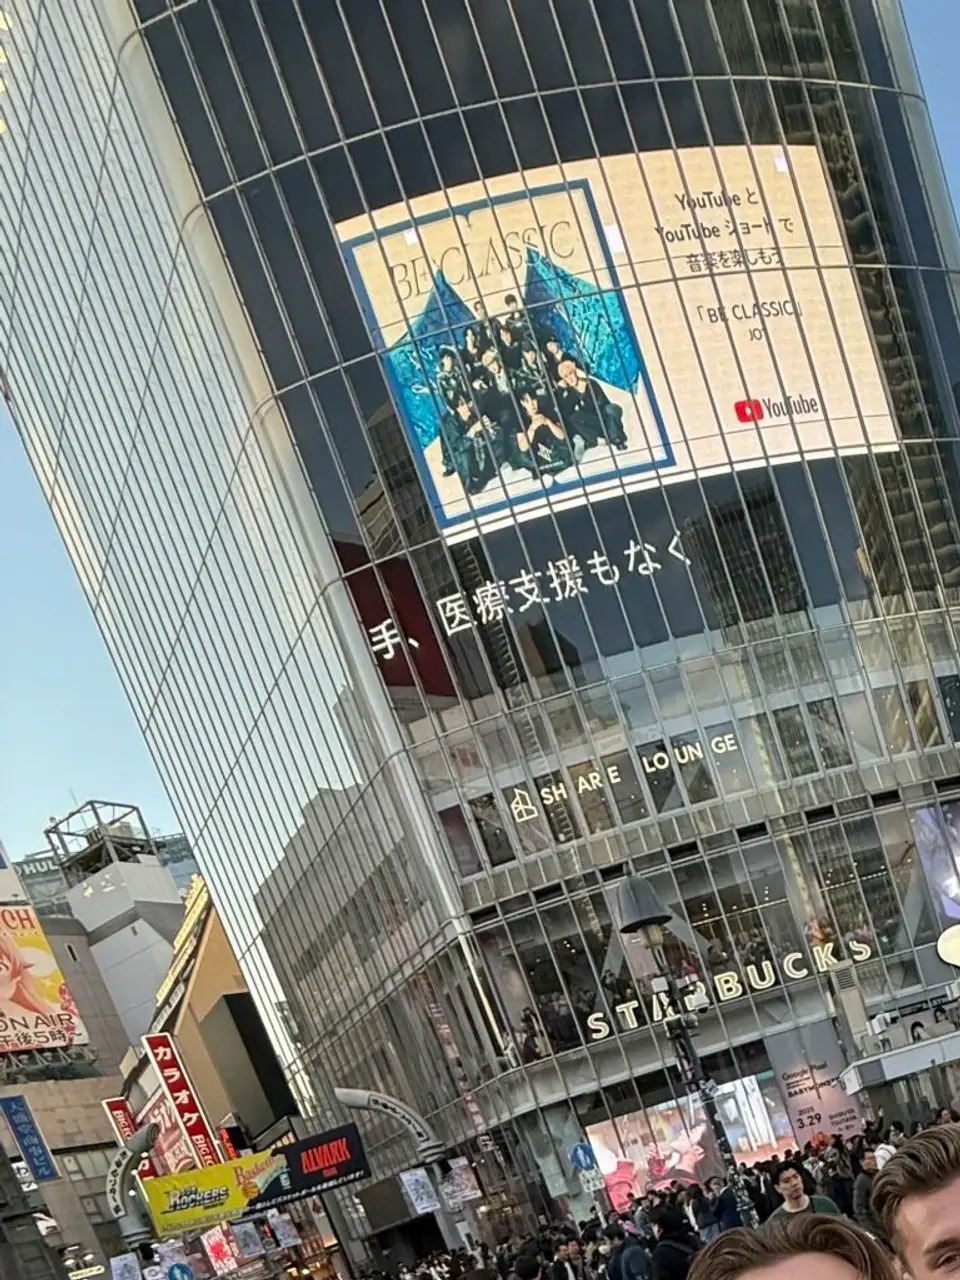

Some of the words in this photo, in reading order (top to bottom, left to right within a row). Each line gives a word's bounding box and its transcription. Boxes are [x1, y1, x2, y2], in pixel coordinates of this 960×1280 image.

[674, 189, 741, 212] YouTube
[654, 222, 721, 243] YouTube
[439, 221, 574, 286] CLASSIC
[686, 247, 784, 273] 音楽を楽しもう
[762, 394, 819, 419] YouTube
[540, 766, 621, 805] SHARE
[642, 733, 738, 773] LOUNGE
[34, 1012, 76, 1030] AIR
[153, 1045, 199, 1128] カラオケ
[300, 1137, 351, 1174] ALVARK
